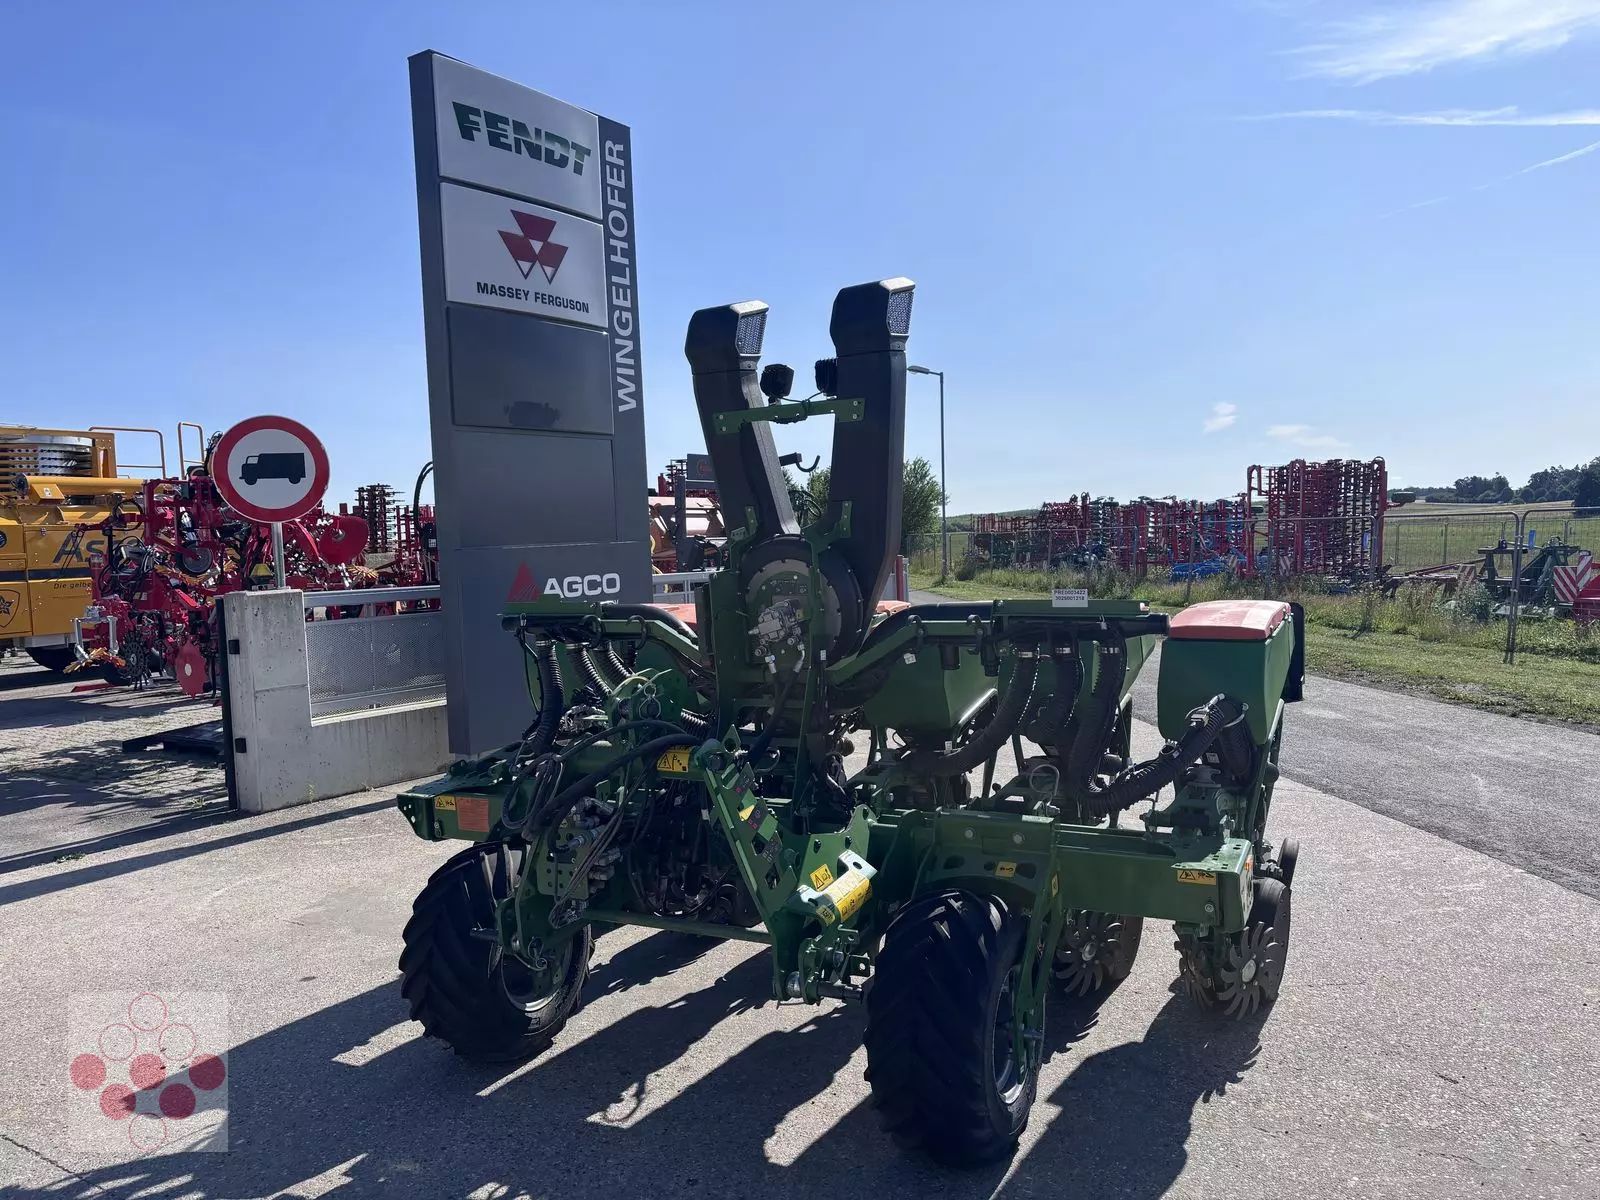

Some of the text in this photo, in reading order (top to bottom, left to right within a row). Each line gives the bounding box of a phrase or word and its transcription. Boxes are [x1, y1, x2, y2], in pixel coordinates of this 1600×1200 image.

[452, 101, 592, 176] FENDT
[476, 281, 590, 314] MASSEY FERGUSON
[605, 140, 637, 412] WINGELHOFER
[543, 573, 621, 598] AGCO
